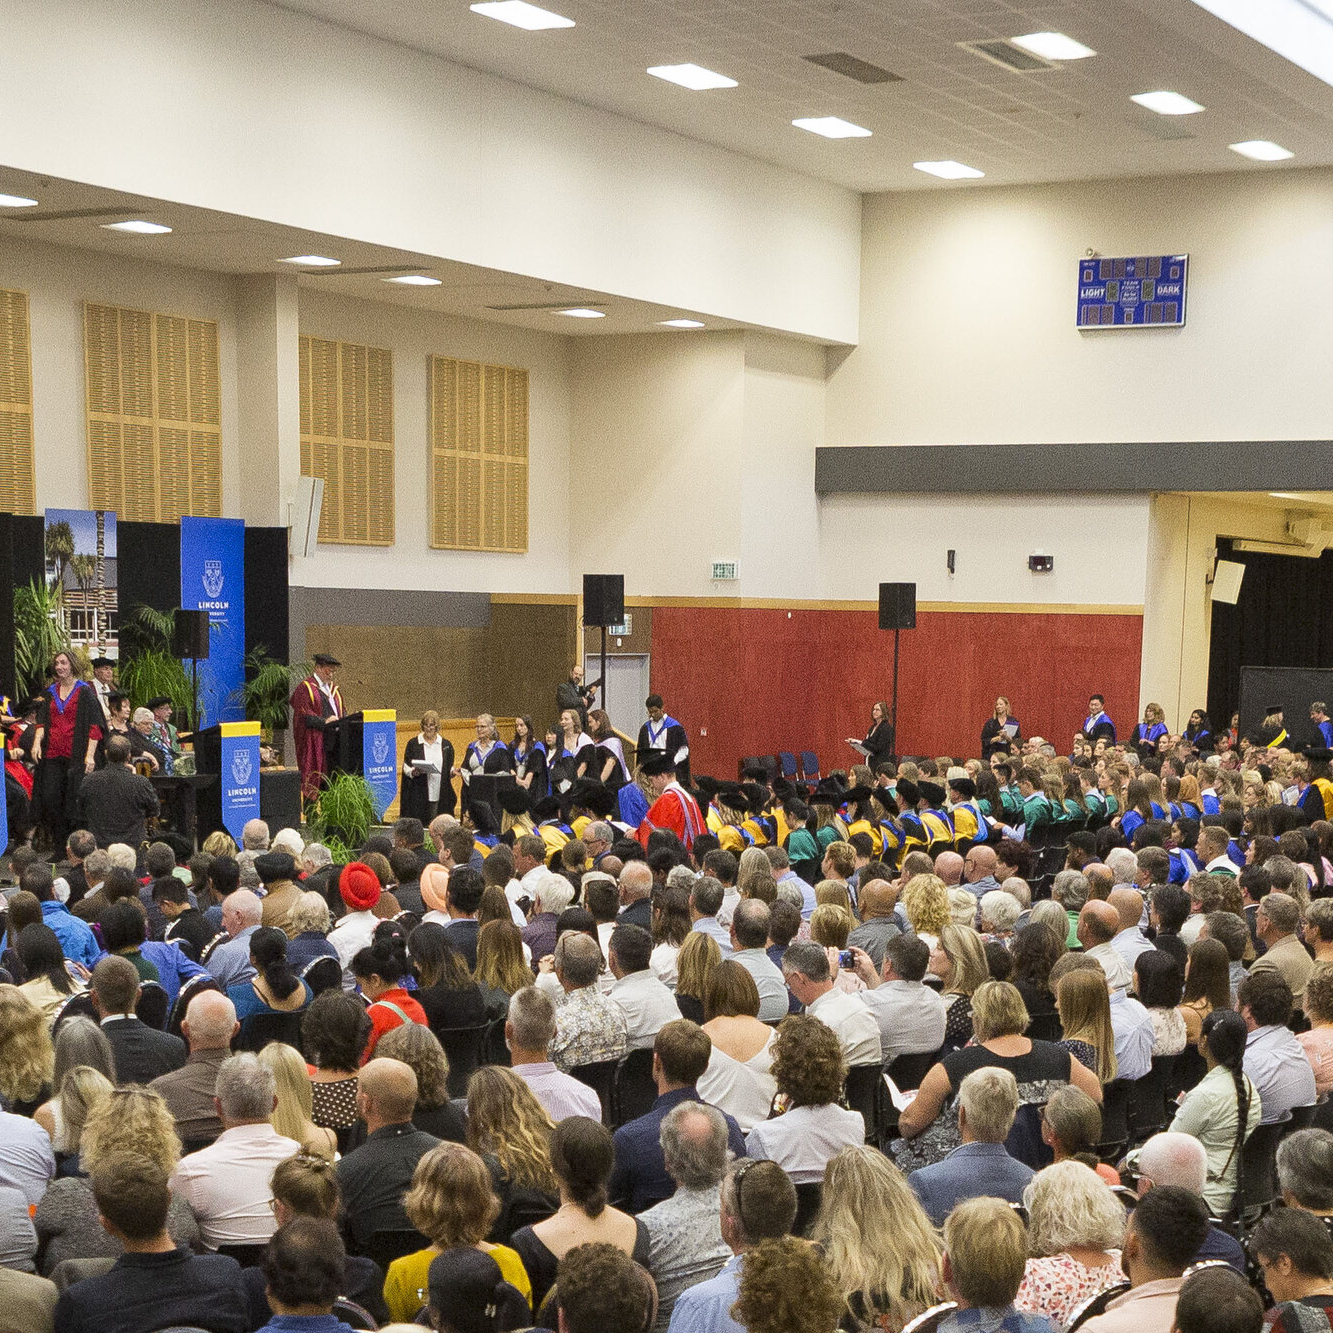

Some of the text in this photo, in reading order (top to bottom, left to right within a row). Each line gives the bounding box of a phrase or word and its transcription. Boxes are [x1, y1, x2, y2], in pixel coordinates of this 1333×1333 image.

[1081, 288, 1105, 298] LIGHT
[1157, 285, 1180, 296] DARK
[198, 601, 229, 609] LINCOLN
[228, 787, 256, 796] LINCOLN
